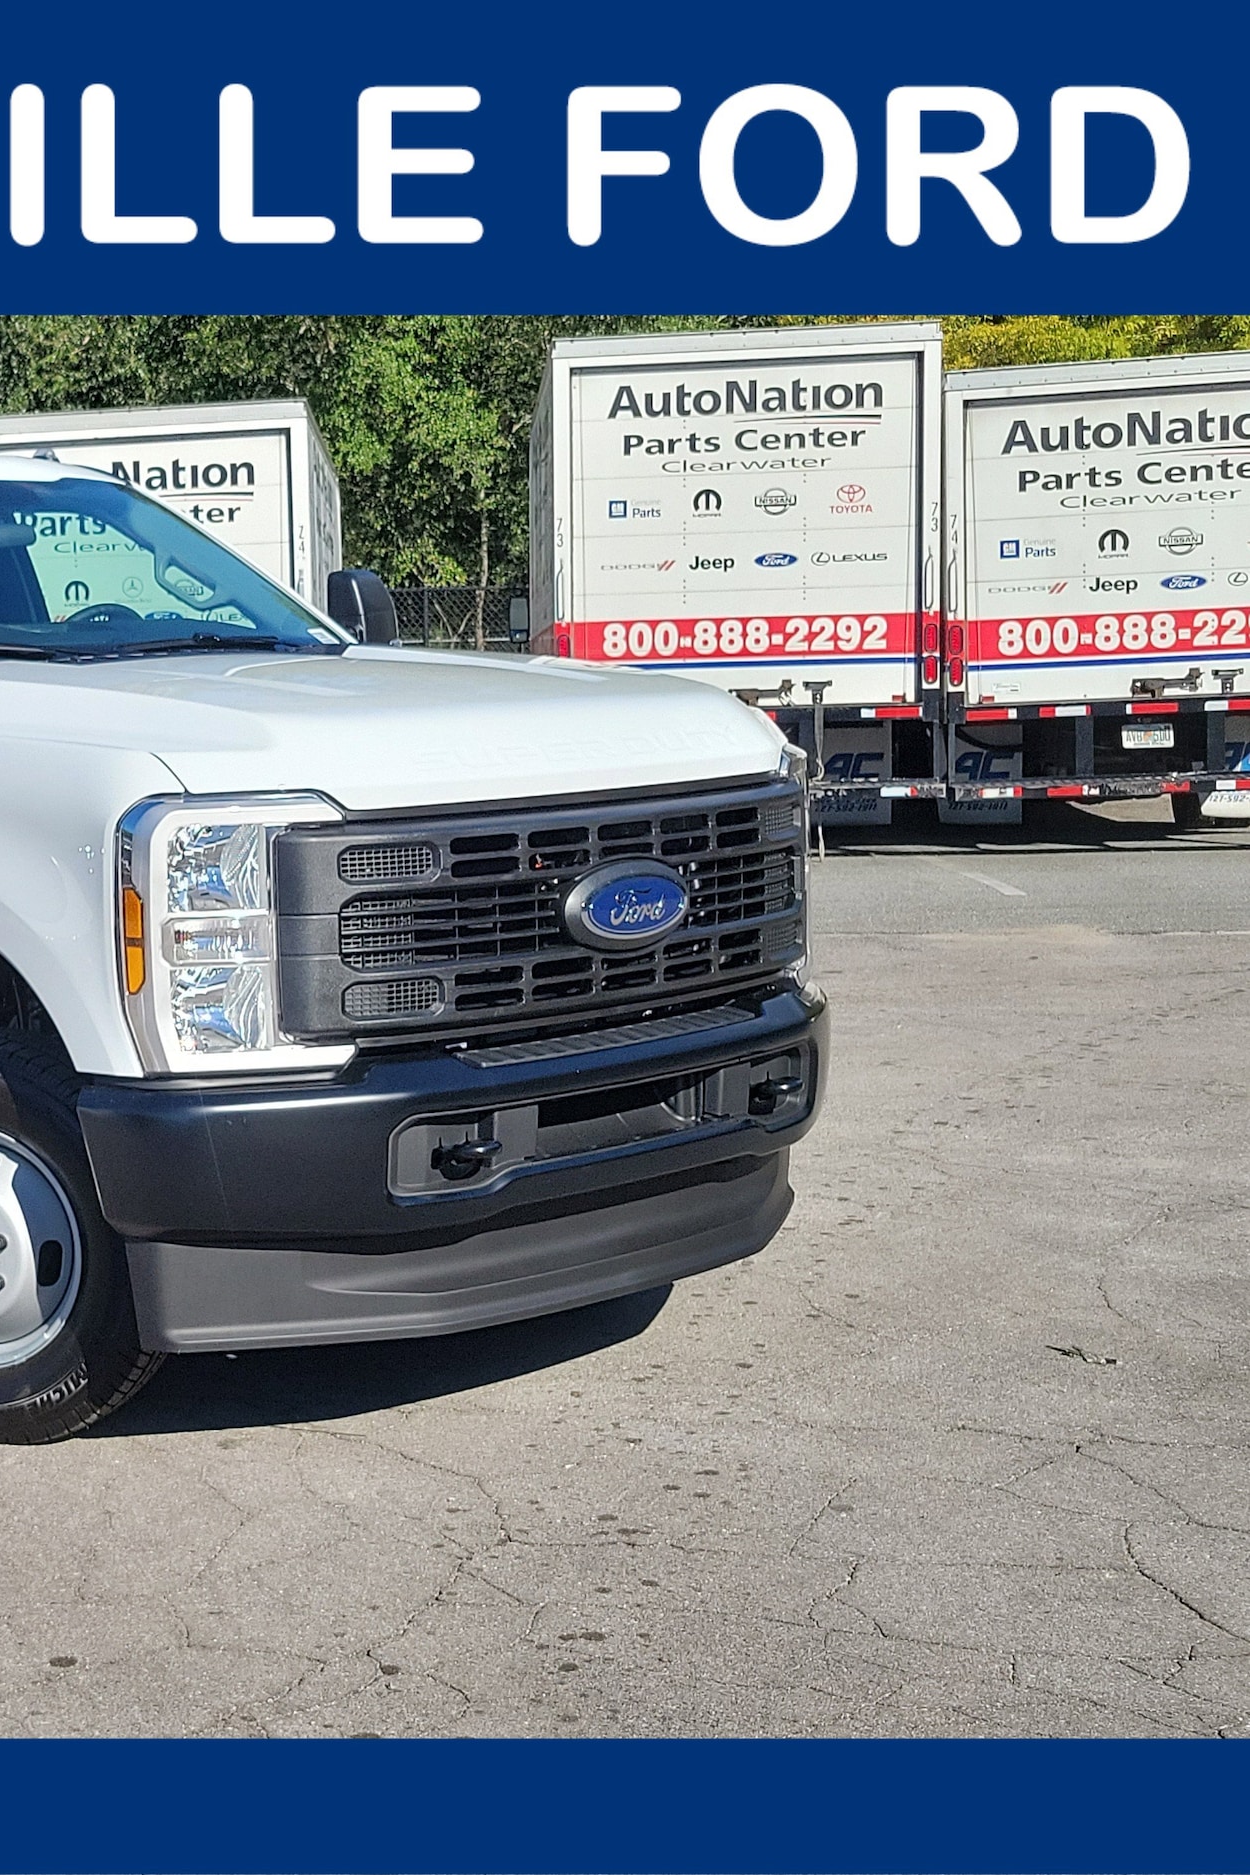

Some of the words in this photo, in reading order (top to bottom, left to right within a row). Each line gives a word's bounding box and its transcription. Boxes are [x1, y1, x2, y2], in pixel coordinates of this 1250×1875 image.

[607, 377, 884, 420] AutoNation
[622, 431, 721, 456] Parts
[734, 426, 866, 452] Center
[661, 456, 832, 474] Clearwater
[1018, 466, 1123, 493] Parts
[1059, 488, 1243, 509] Clearwater
[631, 507, 662, 518] Parts
[829, 503, 874, 514] TOYOTA
[1162, 535, 1199, 545] NISSAN
[761, 554, 792, 567] Ford
[832, 552, 889, 563] LEXUS
[1024, 546, 1057, 558] Parts
[688, 555, 735, 572] Jeep
[1089, 576, 1139, 594] Jeep
[1166, 575, 1201, 589] Ford
[602, 615, 889, 658] 800-888-2292
[997, 609, 1250, 657] 800-888-22
[610, 887, 667, 926] Ford
